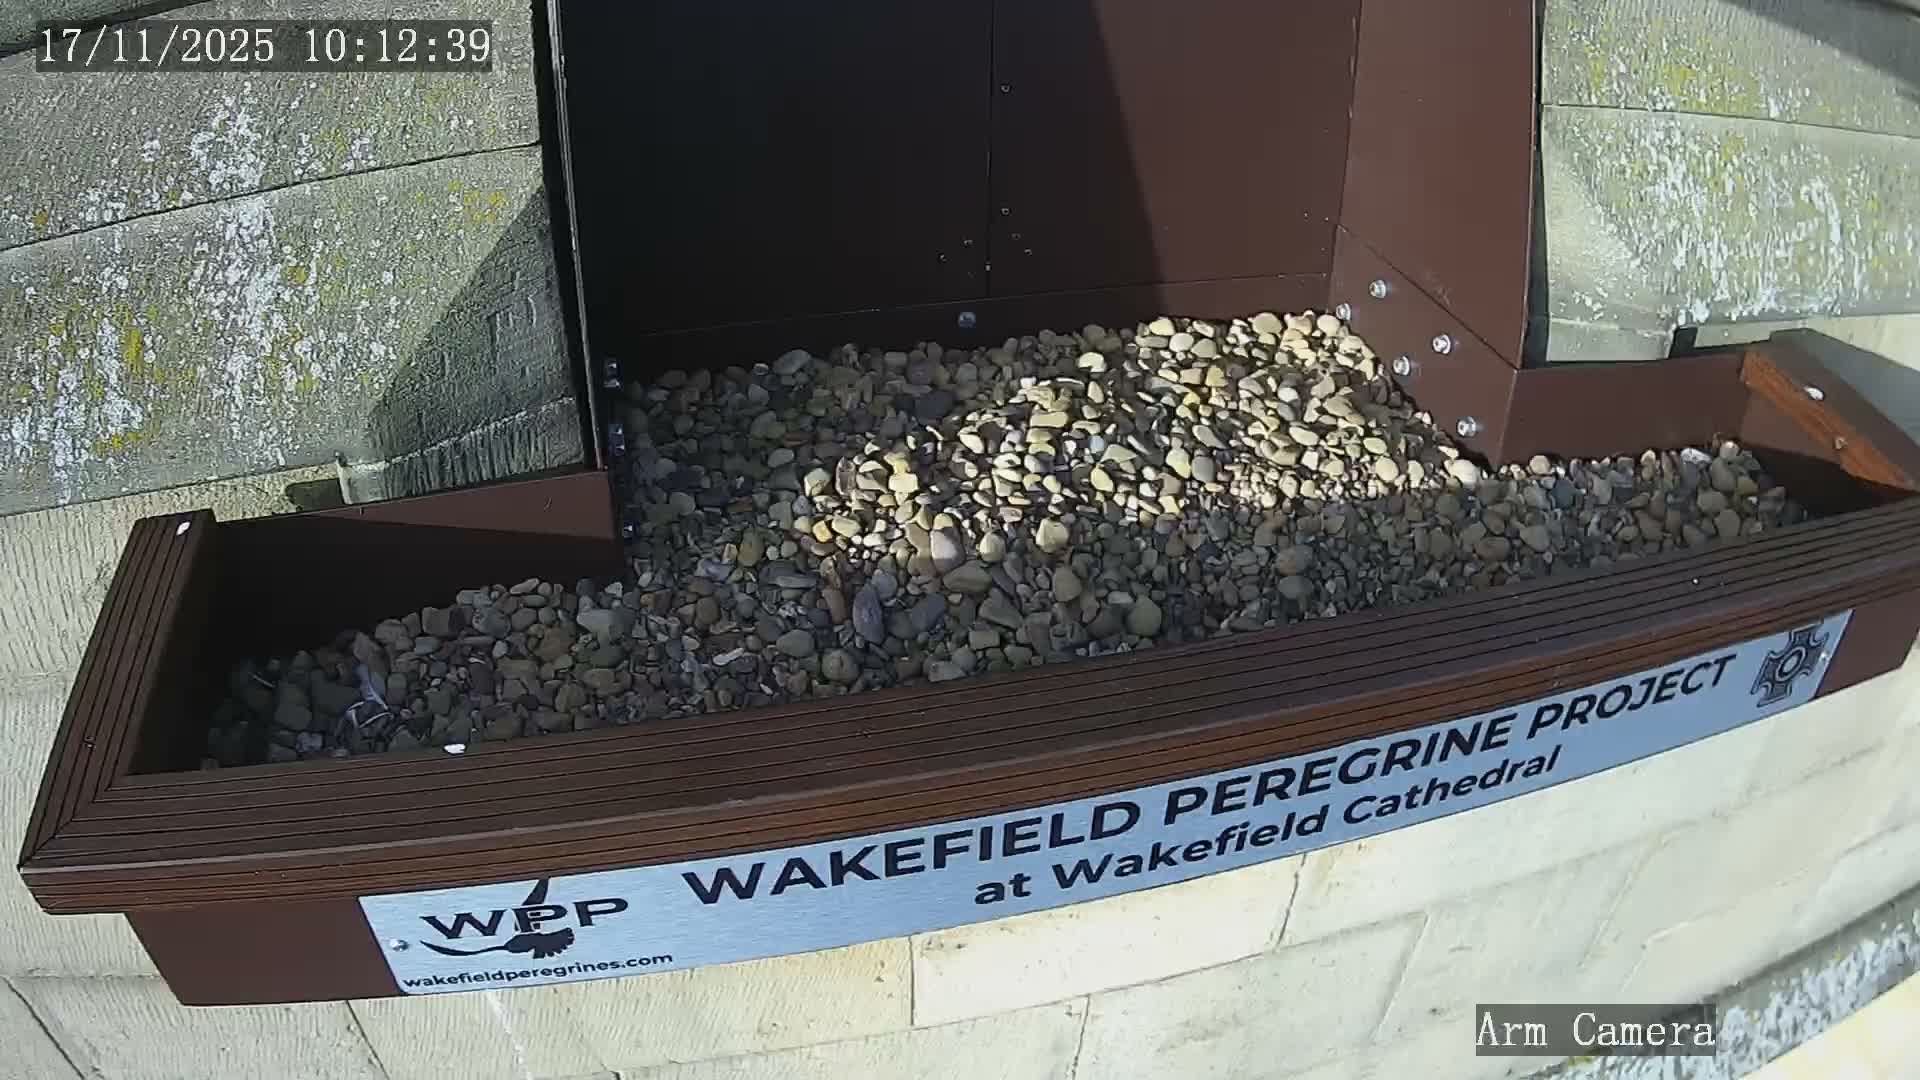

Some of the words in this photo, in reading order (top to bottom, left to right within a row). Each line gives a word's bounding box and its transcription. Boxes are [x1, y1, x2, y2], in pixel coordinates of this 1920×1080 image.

[682, 800, 1141, 905] WAKEFIELD
[1163, 714, 1517, 826] PEREGRINE
[1527, 654, 1738, 739] PROJECT
[974, 874, 1031, 905] at
[1051, 812, 1328, 890] Wakefield
[1343, 746, 1561, 824] Cathedral
[419, 897, 628, 939] WPP
[403, 952, 673, 988] wakefieldperegrines.com
